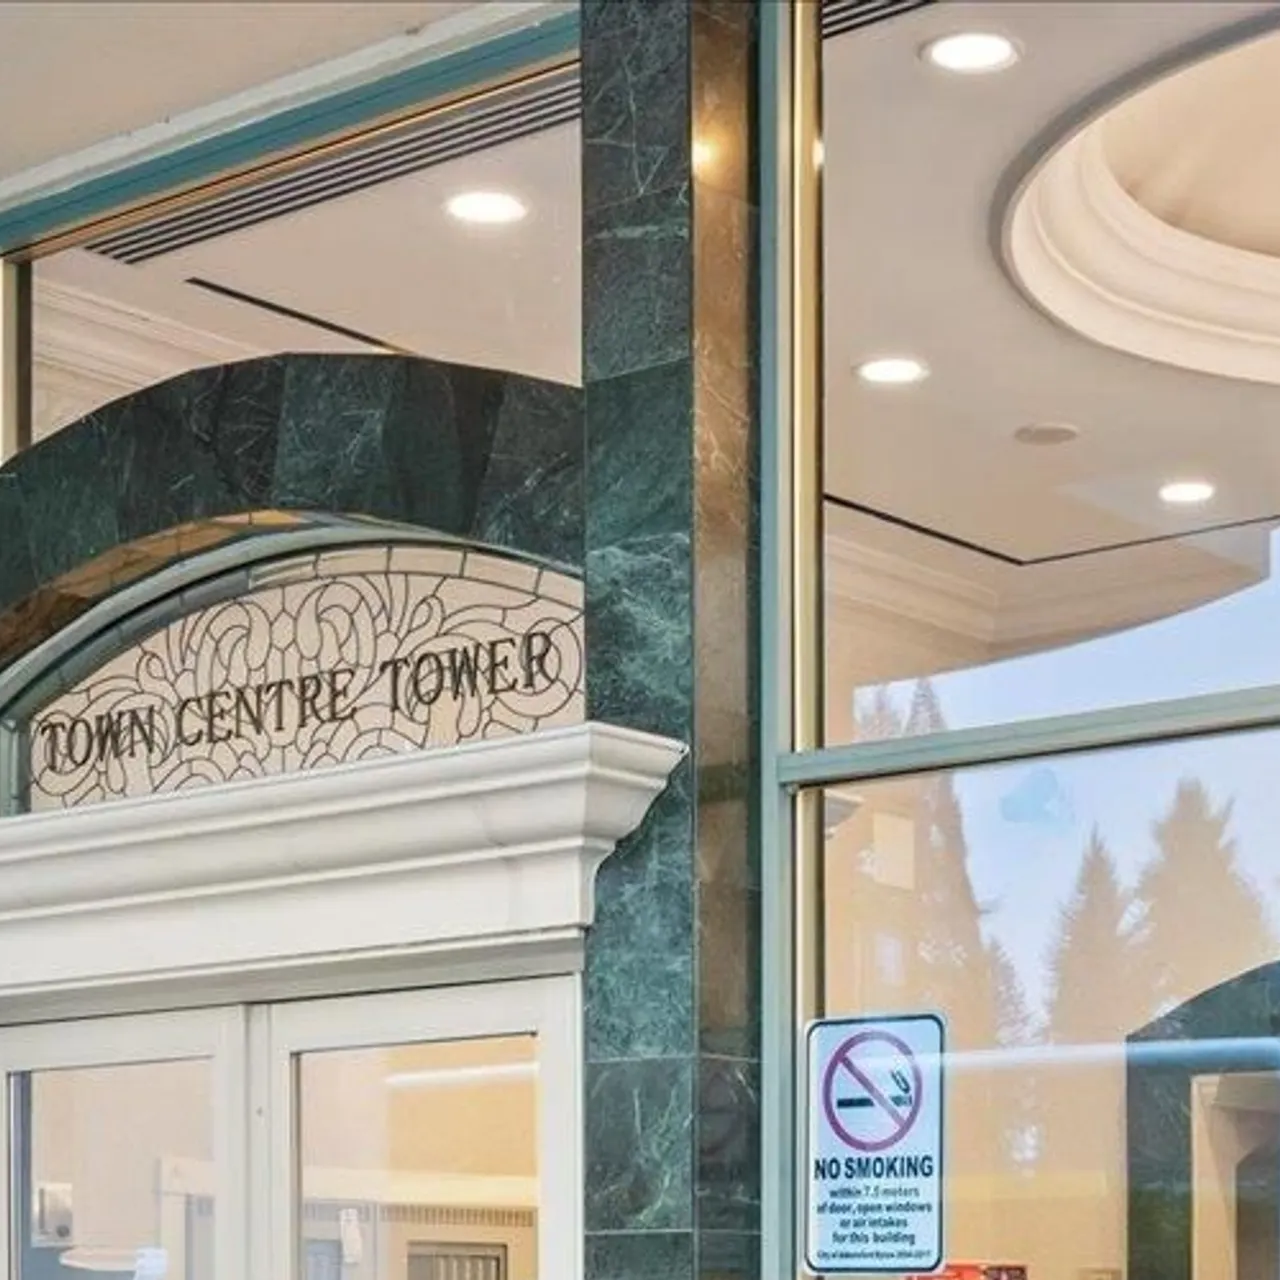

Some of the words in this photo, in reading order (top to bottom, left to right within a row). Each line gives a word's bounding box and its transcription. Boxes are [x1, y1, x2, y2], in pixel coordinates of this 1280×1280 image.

[40, 703, 159, 773] TOWN
[174, 669, 358, 748] CENTRE
[378, 631, 558, 713] TOWER
[814, 1158, 841, 1180] NO
[844, 1155, 934, 1179] SMOKING
[885, 1201, 933, 1213] windows
[872, 1231, 916, 1246] building
